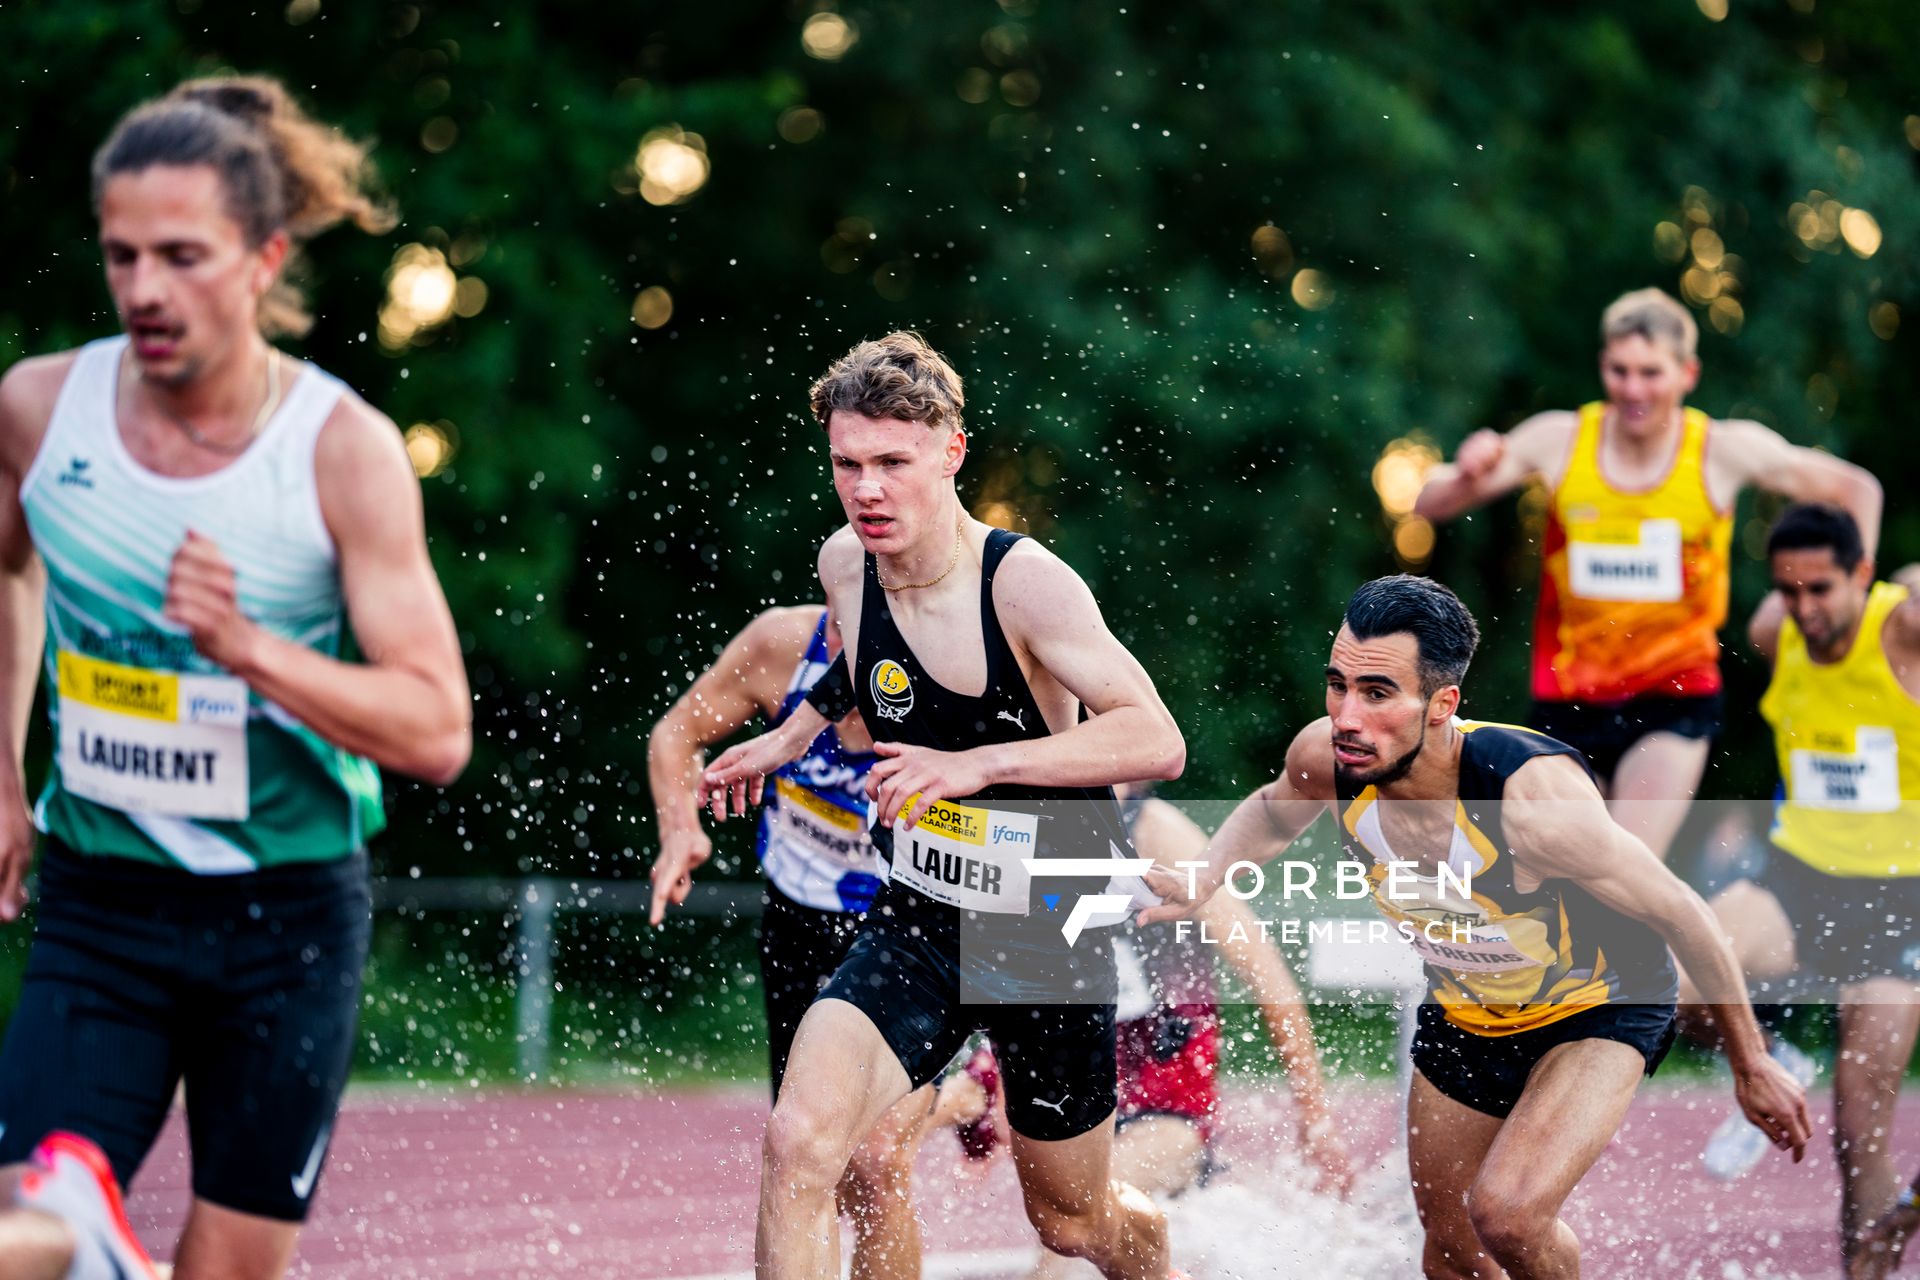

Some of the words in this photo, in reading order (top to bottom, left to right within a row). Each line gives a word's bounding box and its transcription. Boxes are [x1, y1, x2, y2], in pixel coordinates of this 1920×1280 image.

[79, 727, 216, 784] LAURENT
[925, 806, 978, 829] PORT.
[993, 825, 1031, 845] ifam
[912, 840, 1002, 897] LAUER
[1429, 943, 1524, 964] FREITAS
